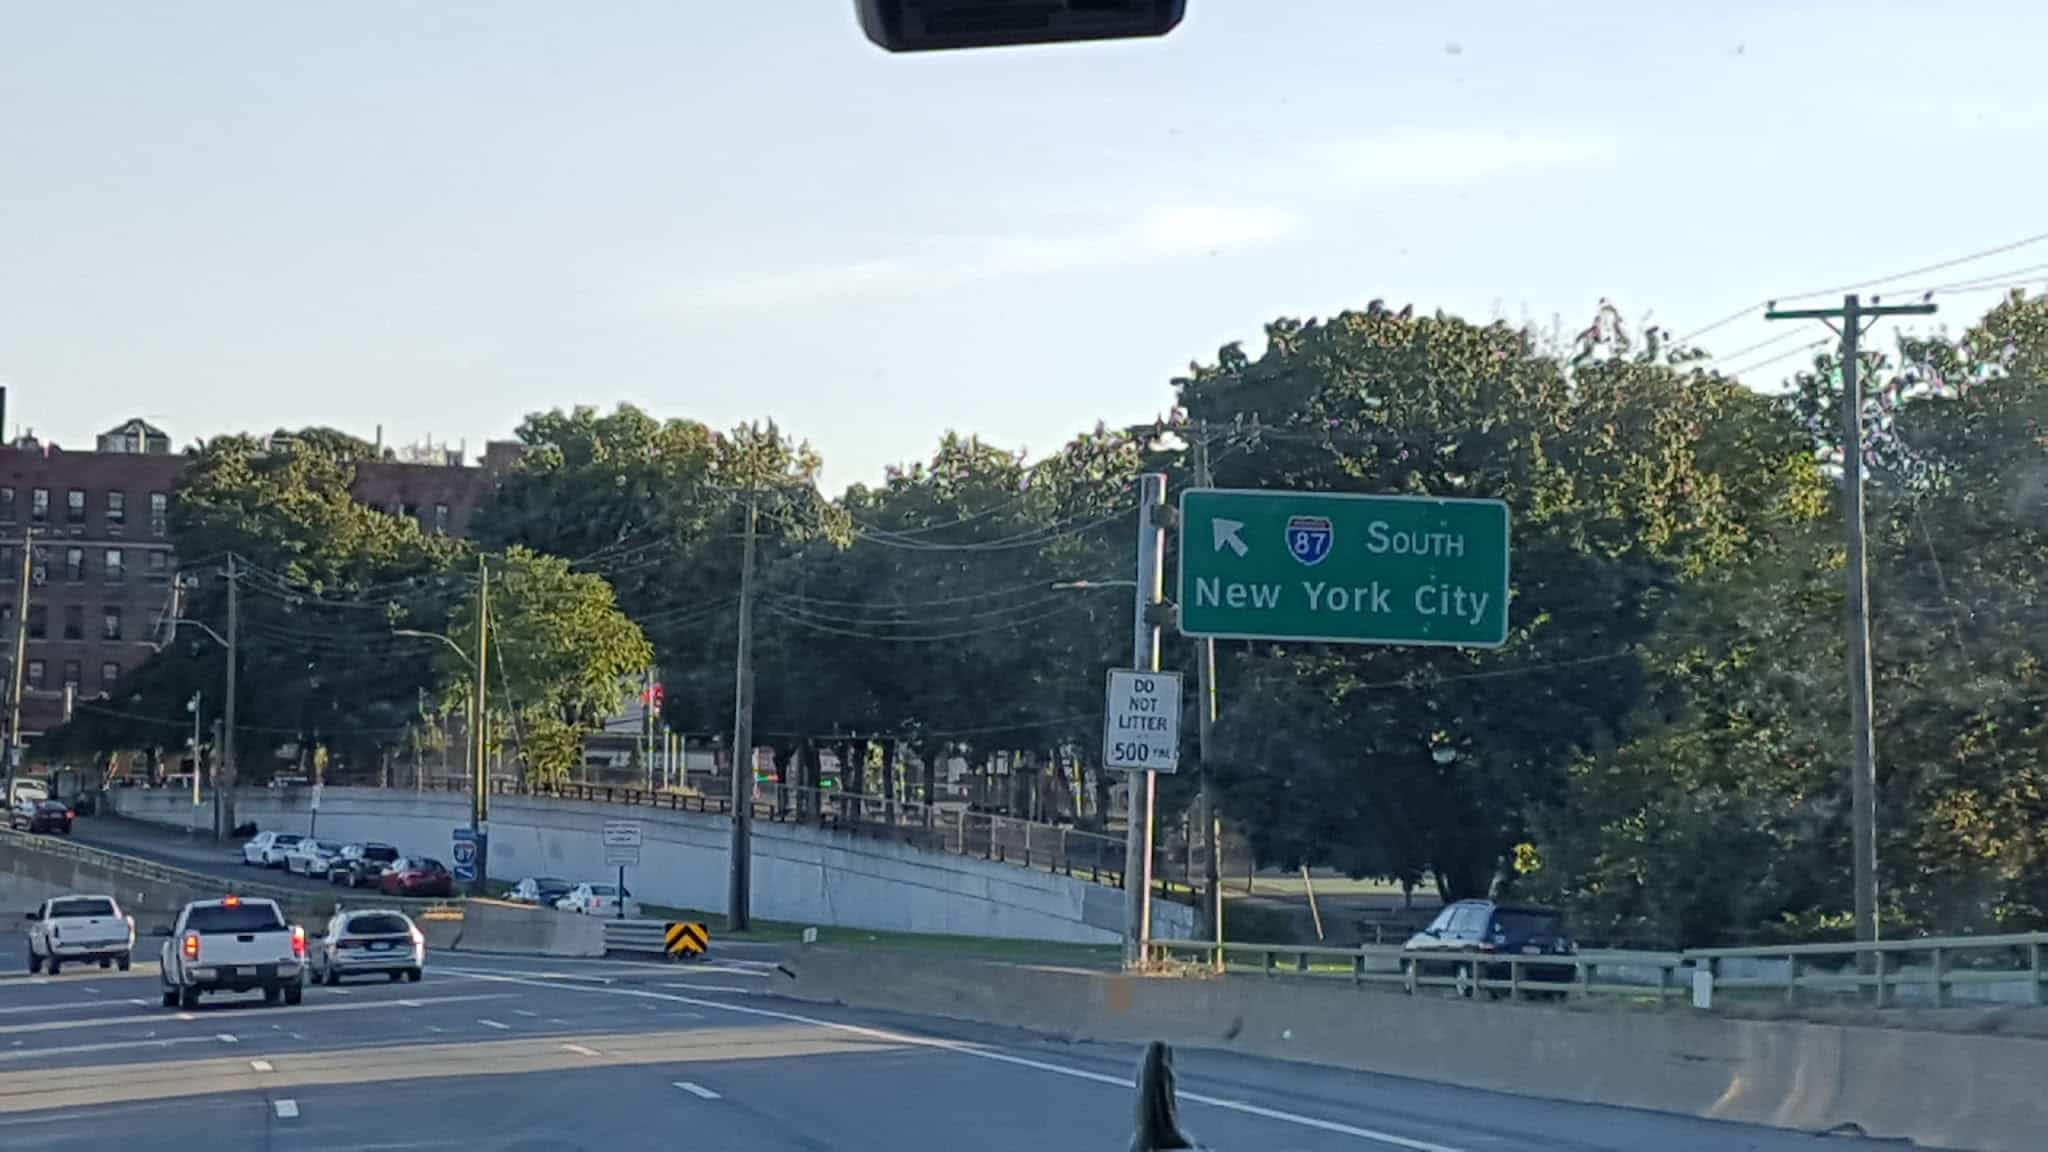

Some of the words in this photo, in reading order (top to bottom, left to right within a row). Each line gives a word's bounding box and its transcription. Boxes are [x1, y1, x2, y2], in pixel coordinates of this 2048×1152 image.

[1295, 532, 1327, 555] 87
[1366, 520, 1465, 557] SOUTH
[1195, 577, 1282, 608] New
[1303, 581, 1392, 613] York
[1415, 585, 1489, 625] City
[1134, 679, 1155, 694] DO
[1128, 696, 1158, 712] NOT
[1119, 713, 1168, 731] LITTER
